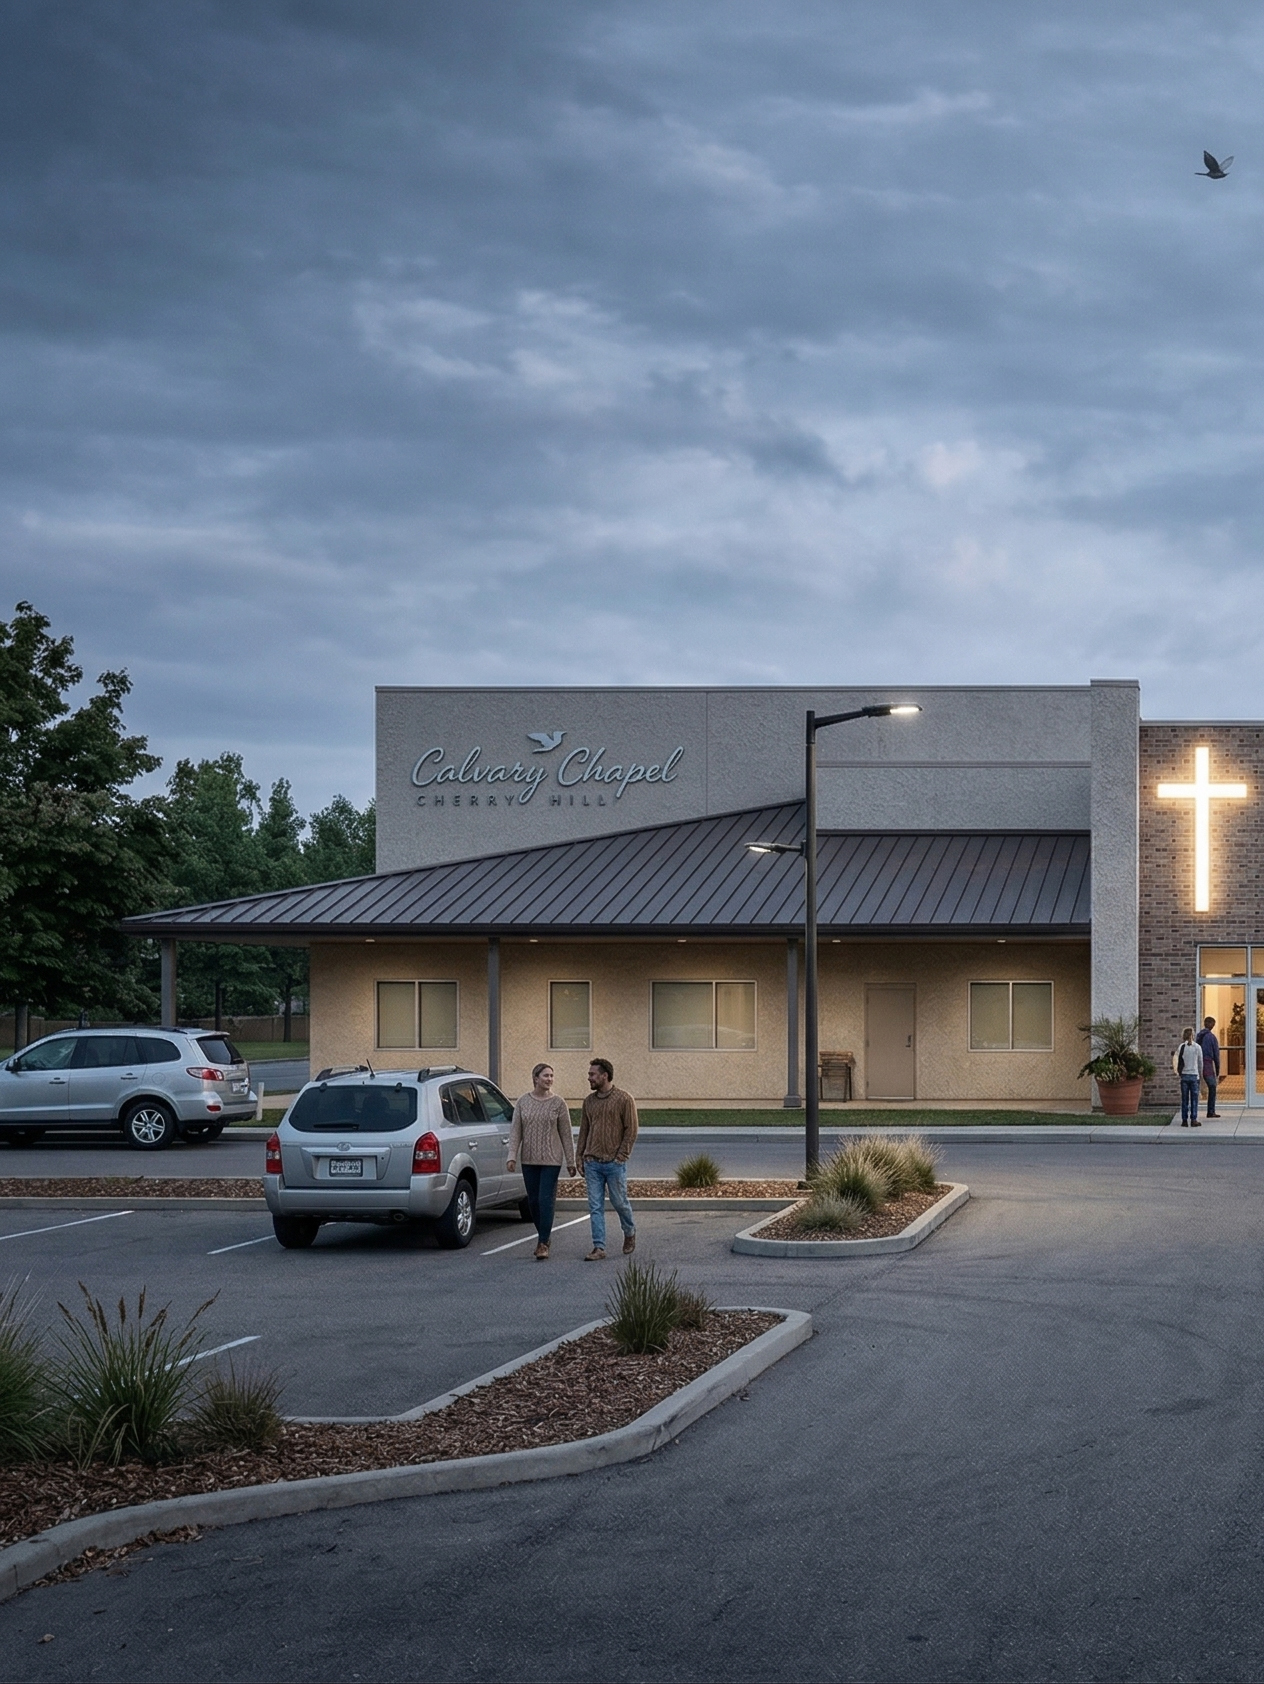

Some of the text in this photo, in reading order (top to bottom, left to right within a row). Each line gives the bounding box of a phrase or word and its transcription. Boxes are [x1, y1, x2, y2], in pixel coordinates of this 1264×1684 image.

[411, 746, 684, 804] Calvary Chapel
[416, 794, 606, 807] CHERRY HILL
